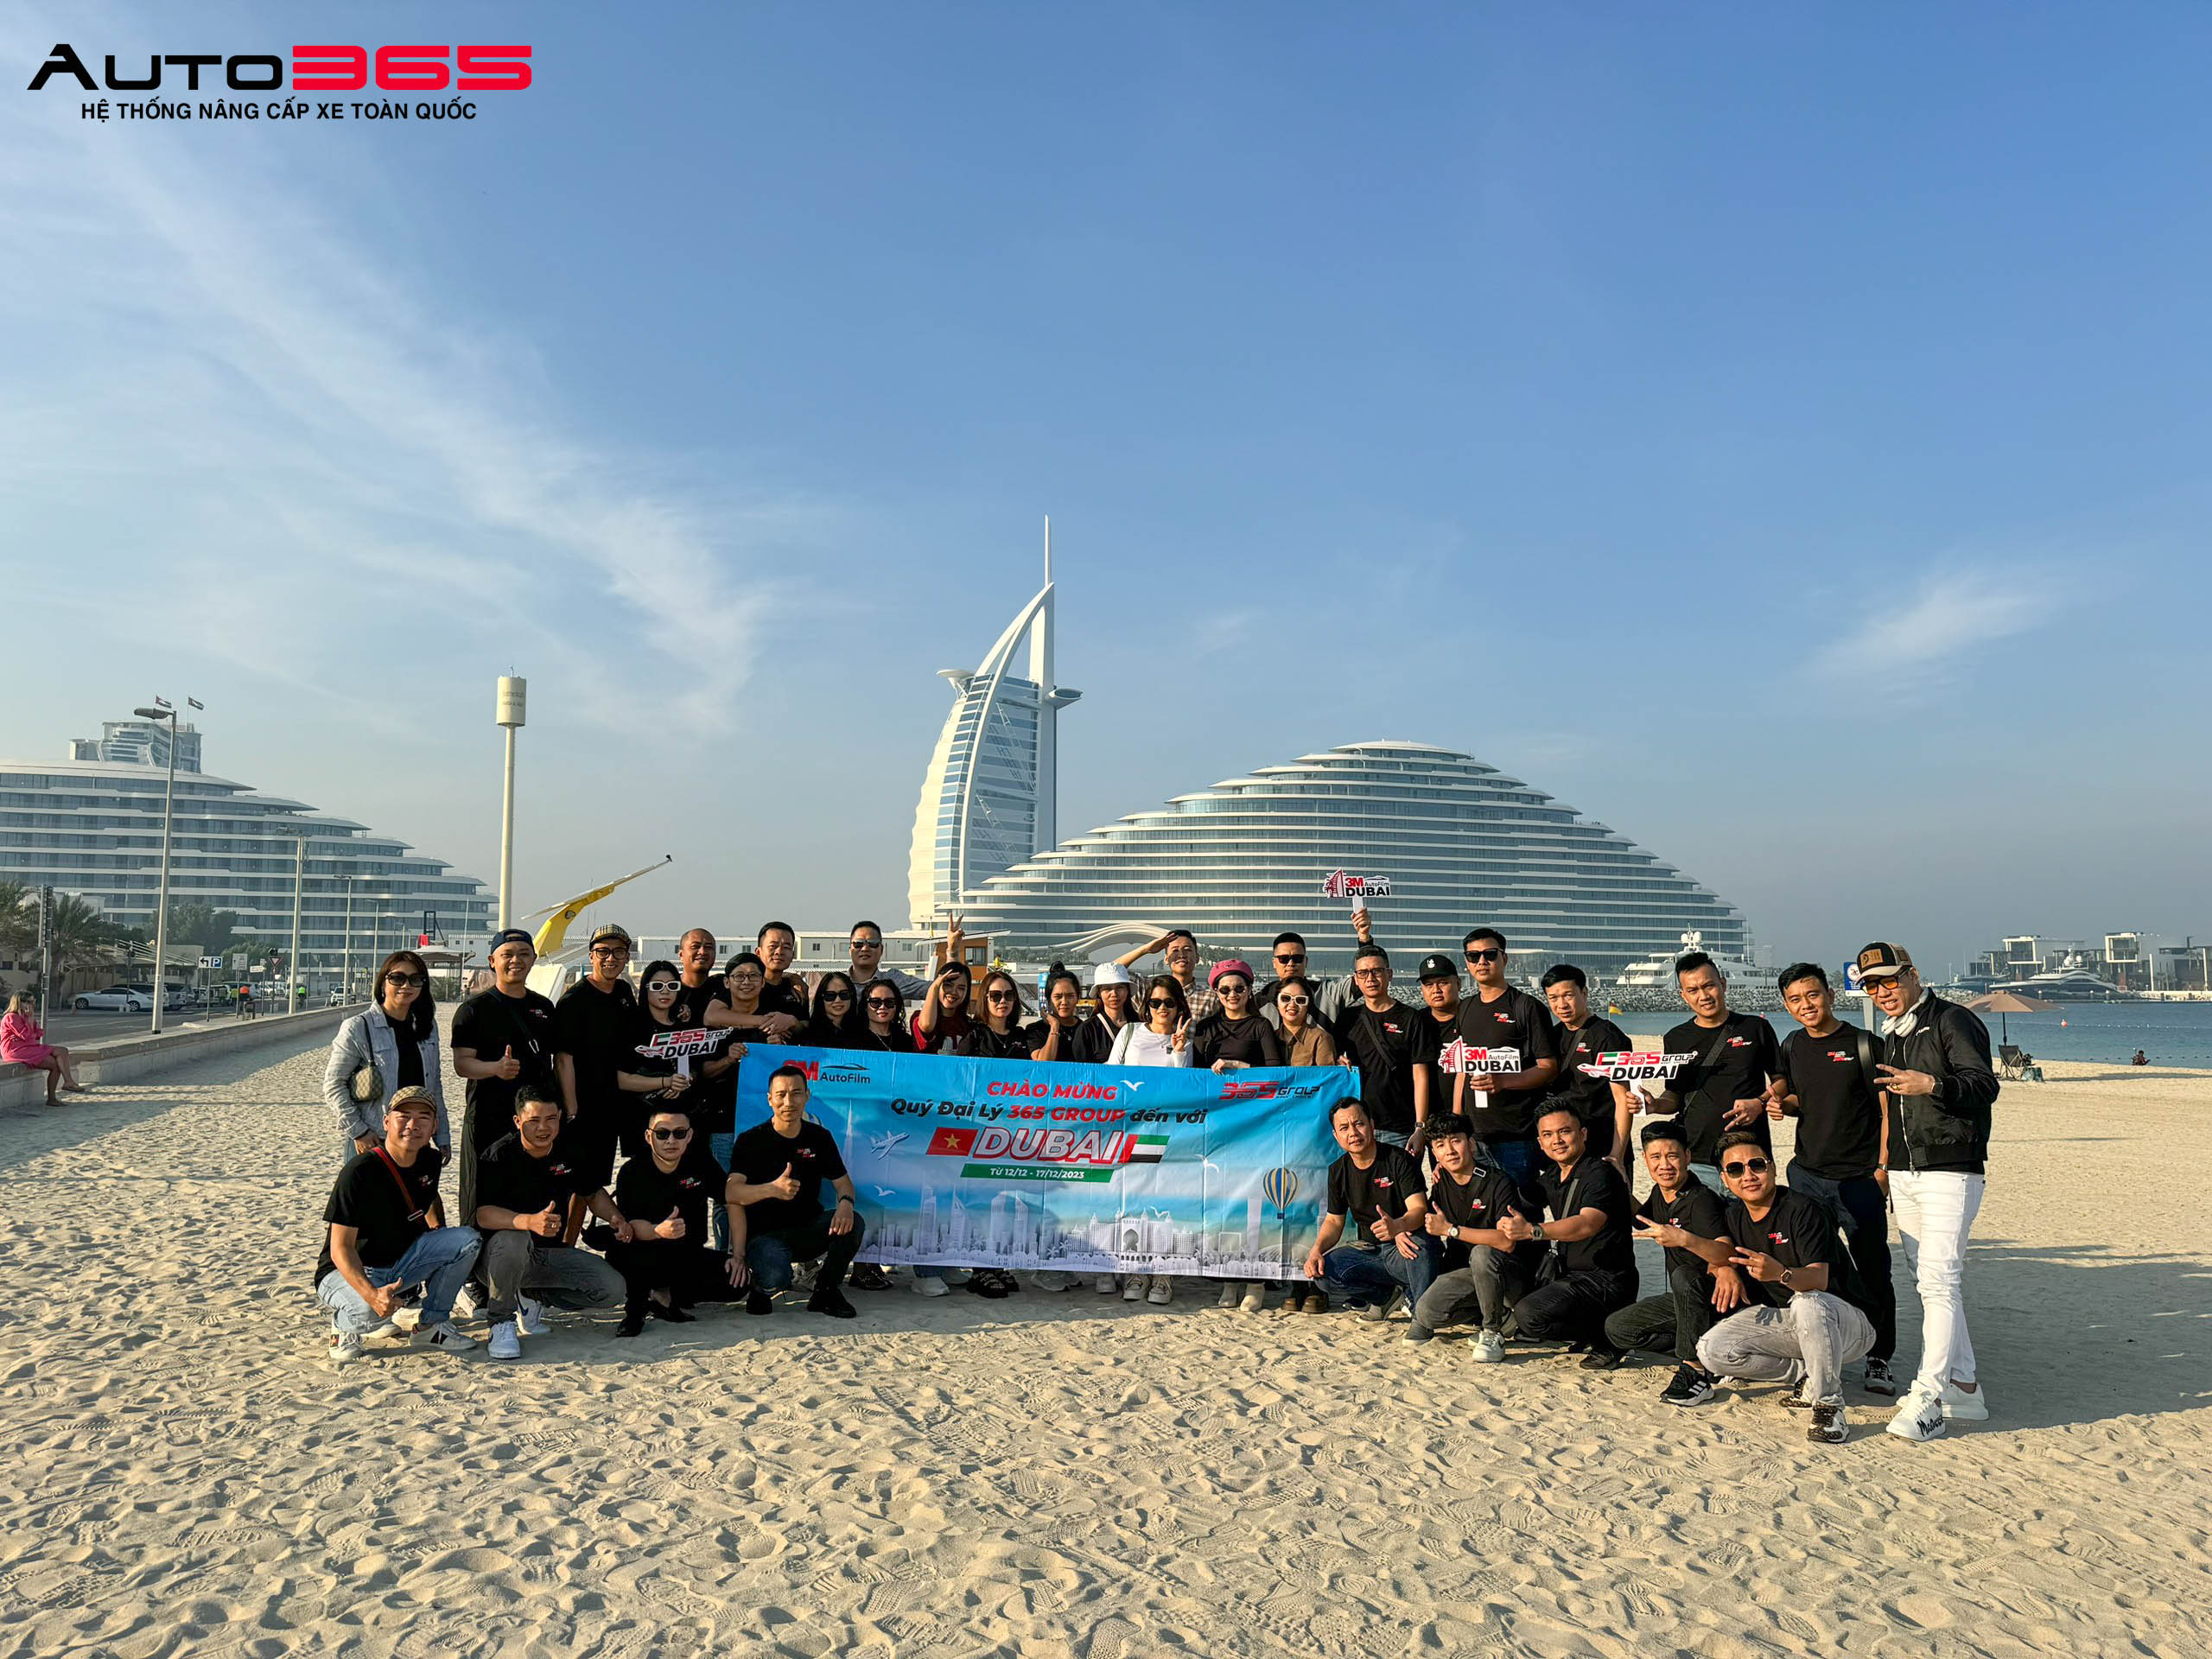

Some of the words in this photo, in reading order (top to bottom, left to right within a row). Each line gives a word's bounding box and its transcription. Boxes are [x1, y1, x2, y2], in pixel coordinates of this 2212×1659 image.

[1345, 877, 1364, 887] 3M
[1345, 887, 1390, 897] DUBAI
[664, 1039, 718, 1058] DUBAI
[1465, 1048, 1486, 1060] 3M
[1465, 1060, 1520, 1071] DUBAI
[820, 1071, 872, 1084] AutoFilm
[1611, 1065, 1677, 1080] DUBAI
[987, 1078, 1048, 1097] CHÀO
[1052, 1081, 1118, 1101] MỪNG
[891, 1098, 933, 1117] Quý
[938, 1101, 976, 1120] Đại
[978, 1103, 1004, 1122] Lý
[1007, 1105, 1046, 1120] 365
[1050, 1106, 1126, 1122] GROUP
[1129, 1107, 1169, 1123] đến
[1175, 1109, 1209, 1124] với
[972, 1126, 1125, 1165] DUBAI
[1005, 1168, 1027, 1178] 12/12
[1036, 1169, 1085, 1179] 17/12/2023
